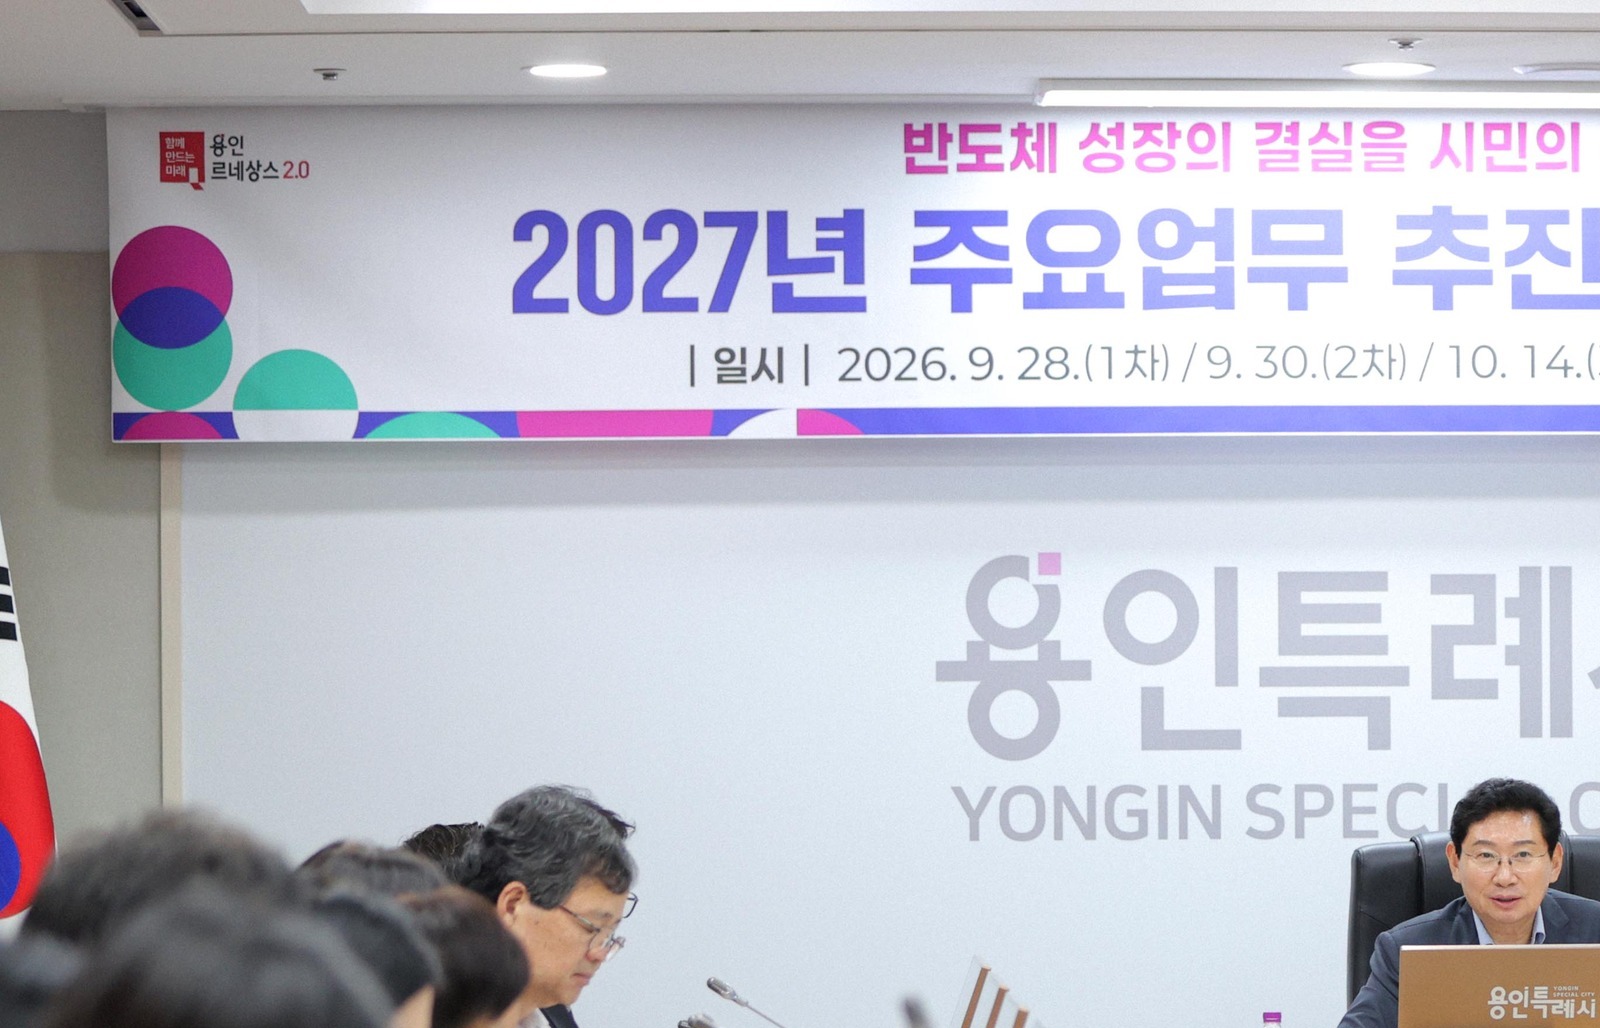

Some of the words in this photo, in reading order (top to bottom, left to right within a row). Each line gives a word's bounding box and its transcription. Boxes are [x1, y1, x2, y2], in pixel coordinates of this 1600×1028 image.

[165, 151, 196, 163] 만드는
[209, 133, 244, 157] 용인
[904, 120, 1058, 175] 반도체
[1078, 120, 1233, 175] 성장의
[1255, 120, 1408, 174] 결실을
[1429, 120, 1582, 174] 시민의
[165, 165, 187, 177] 미래
[211, 160, 280, 182] 르네상스
[283, 160, 310, 180] 2.0
[512, 208, 868, 316] 2027년
[909, 207, 1350, 314] 주요업무
[714, 346, 785, 386] 일시
[837, 345, 957, 384] 2026.
[951, 784, 1222, 842] YONGIN
[1246, 782, 1450, 840] SPECI
[1487, 985, 1596, 1020] 용인특례시
